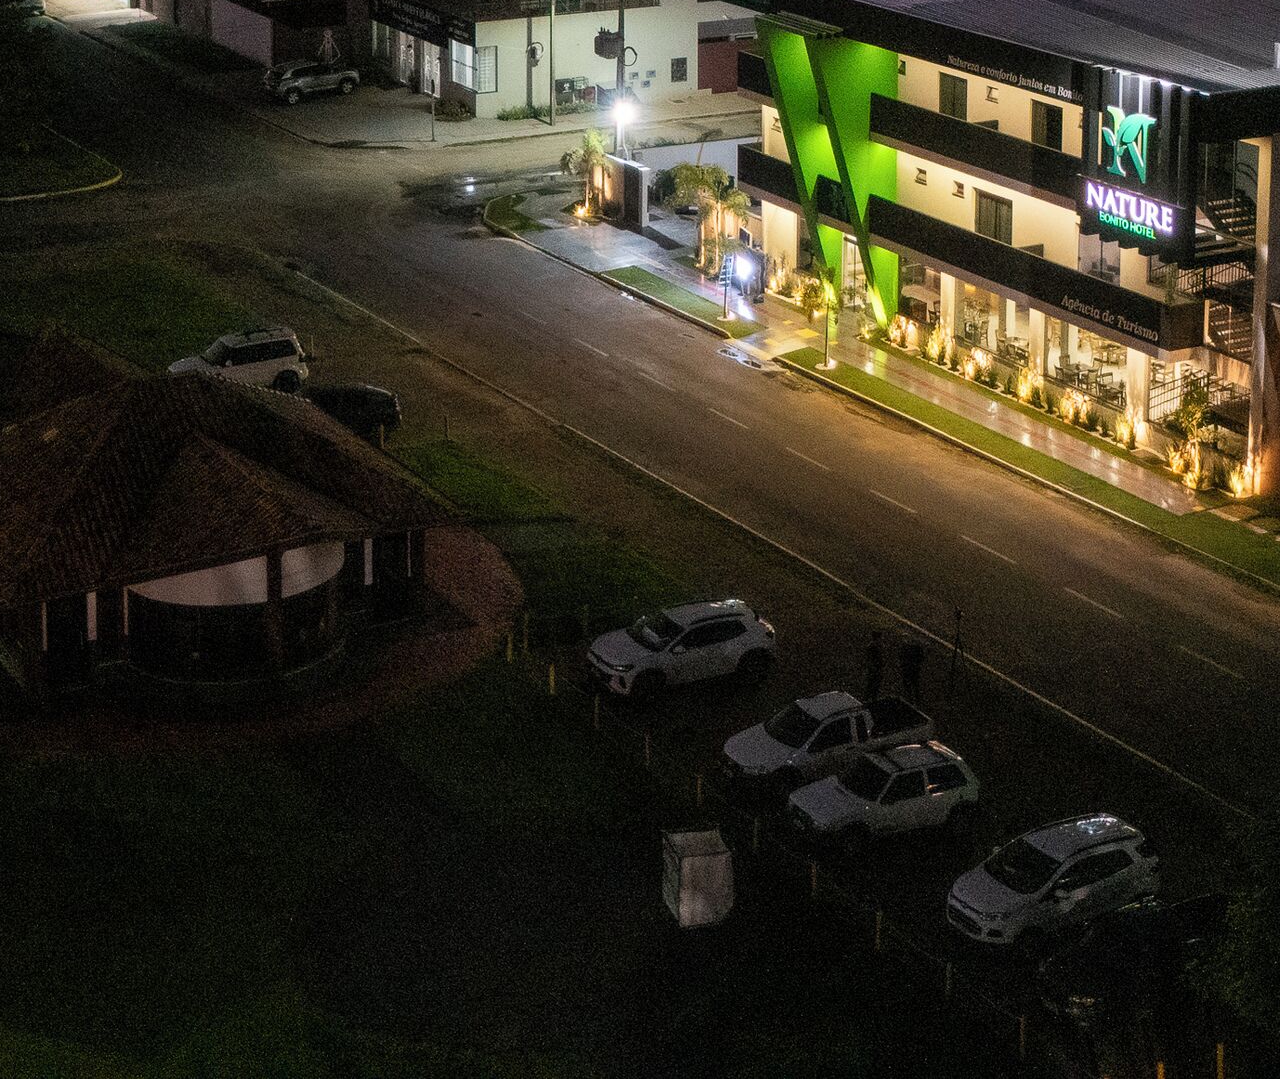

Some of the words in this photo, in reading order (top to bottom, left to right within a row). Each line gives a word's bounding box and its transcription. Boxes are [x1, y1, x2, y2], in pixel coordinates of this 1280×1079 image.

[947, 55, 980, 72] Natureza
[980, 65, 986, 74] e
[986, 67, 1018, 83] conforto
[1018, 74, 1043, 90] juntos
[1043, 84, 1056, 94] em
[1057, 85, 1084, 100] Bonito
[1086, 180, 1173, 233] NATURE
[1099, 210, 1128, 230] BONITO
[1129, 222, 1157, 240] HOTEL
[1061, 295, 1100, 320] Agência
[1102, 310, 1115, 324] de
[1117, 315, 1159, 341] Turismo
